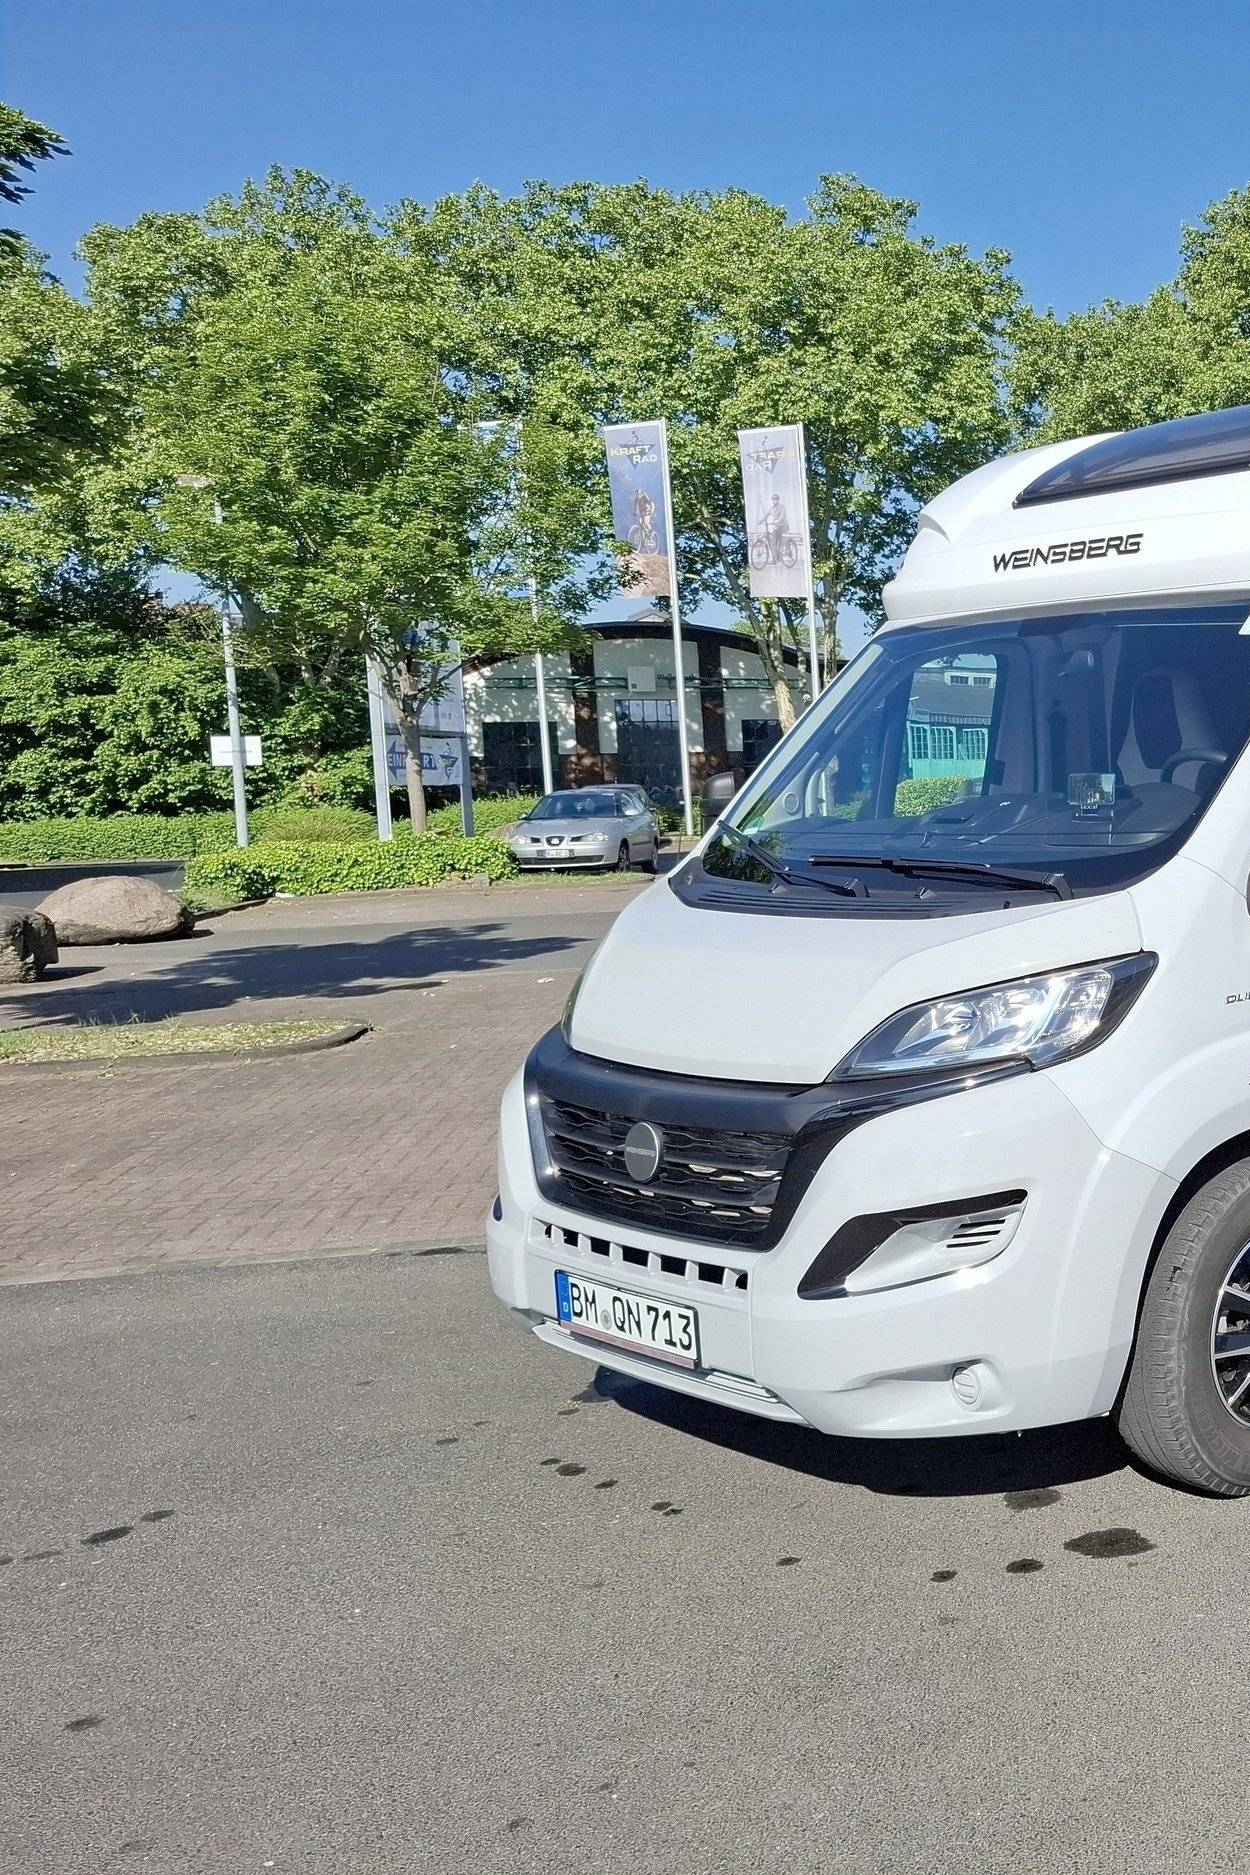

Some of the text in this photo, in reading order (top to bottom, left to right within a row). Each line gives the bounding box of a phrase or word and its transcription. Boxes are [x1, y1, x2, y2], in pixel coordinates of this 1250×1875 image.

[610, 445, 651, 456] KRAFT
[633, 454, 657, 464] RAD
[993, 532, 1144, 573] WEINSBERG
[570, 1282, 692, 1351] BM QN 713
